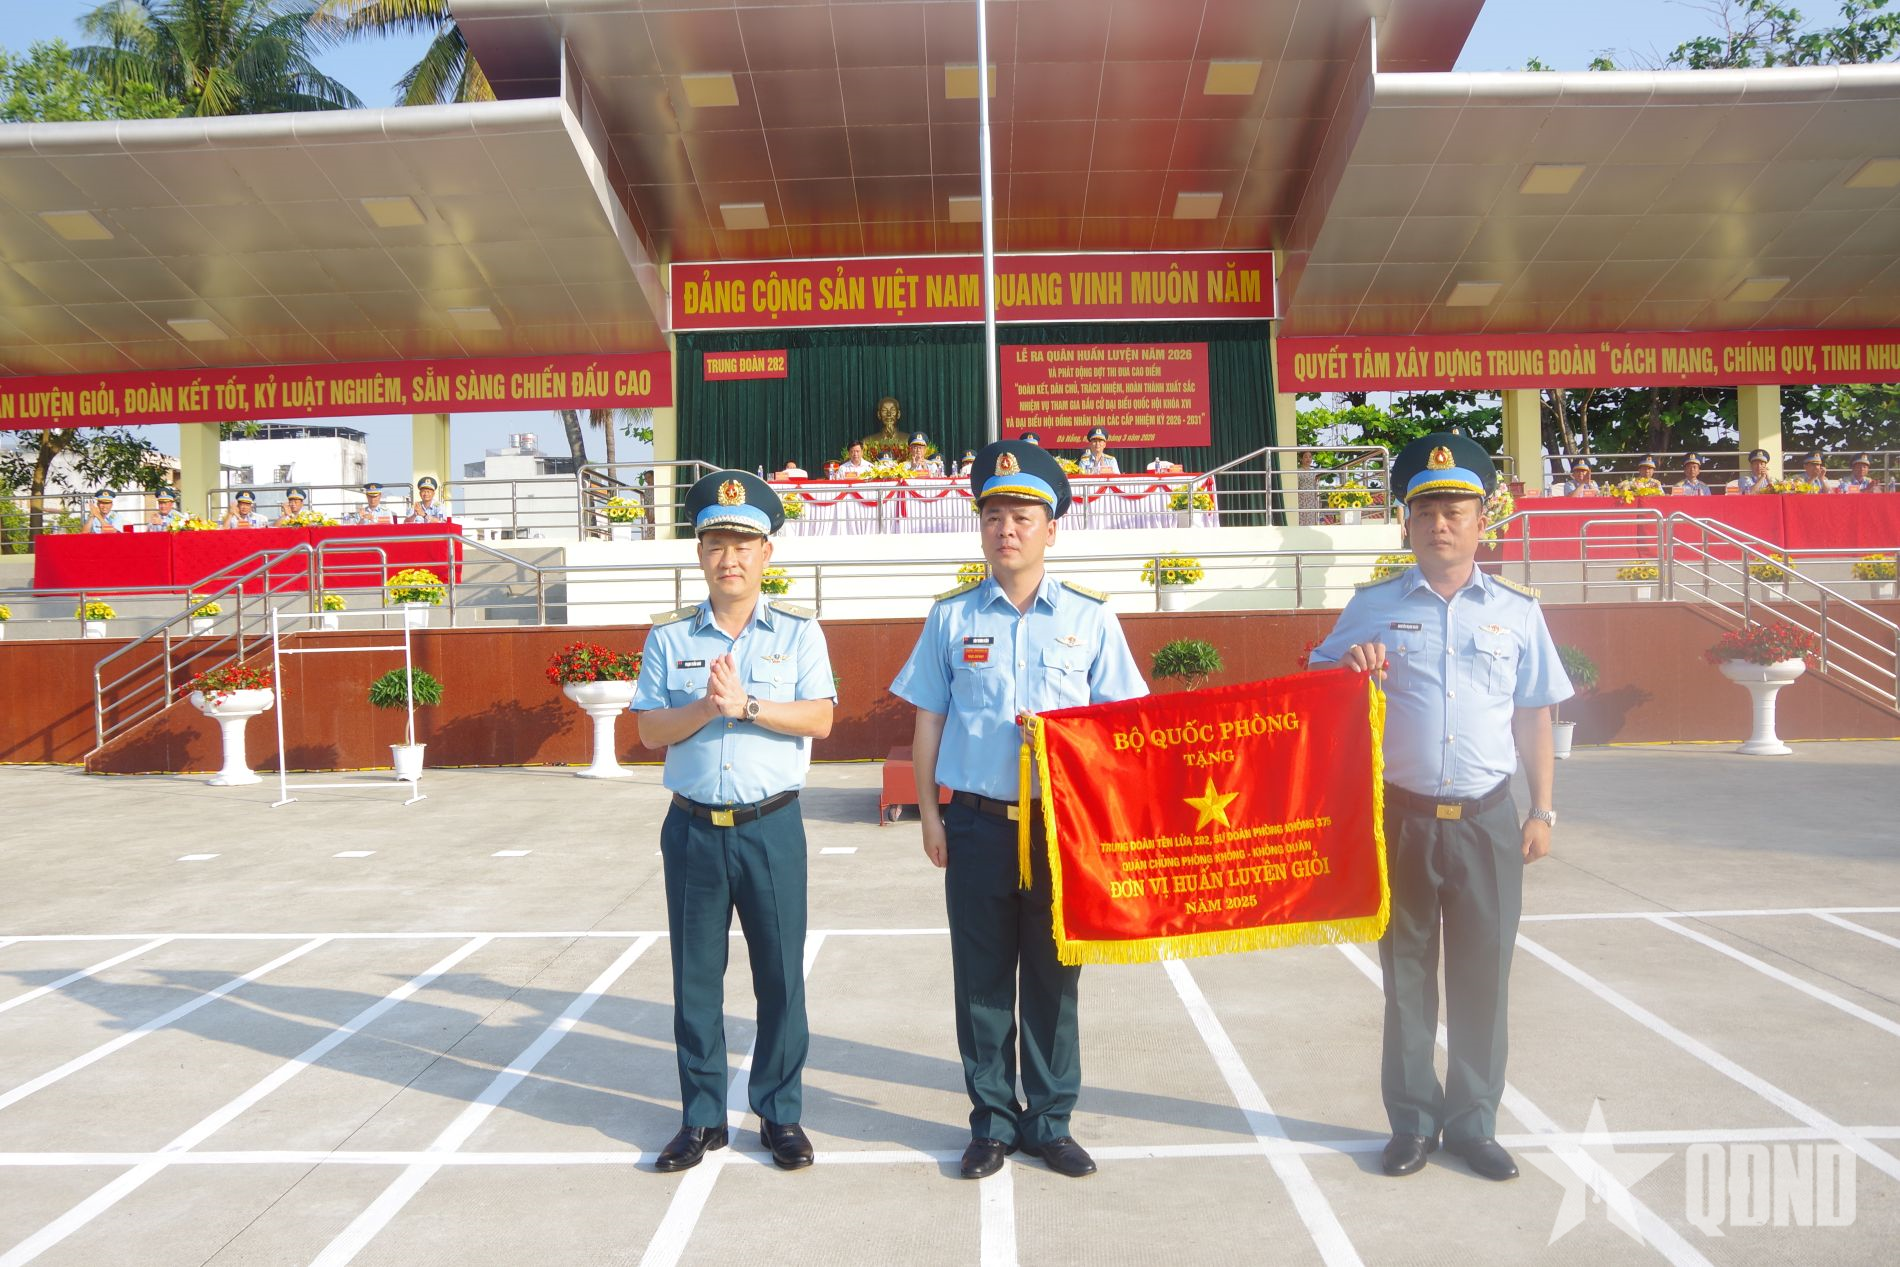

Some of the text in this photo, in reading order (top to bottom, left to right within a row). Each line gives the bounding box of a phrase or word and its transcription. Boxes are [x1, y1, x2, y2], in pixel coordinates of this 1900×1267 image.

[684, 270, 745, 314] ĐẢNG
[752, 271, 811, 319] CỘNG
[819, 266, 864, 310] SẢN
[872, 268, 918, 316] VIỆT
[926, 274, 979, 307] NAM
[1070, 271, 1122, 305] VINH
[1131, 262, 1198, 304] MUÔN
[1207, 261, 1260, 303] NĂM
[1016, 346, 1192, 362] LỄ RA QUÂN HUẤN LUYỆN NĂM 2026
[1294, 345, 1347, 382] QUYẾT
[1353, 347, 1390, 378] TÂM
[1396, 346, 1429, 377] XÂY
[1435, 348, 1482, 382] DỰNG
[1487, 350, 1544, 376] TRUNG
[1549, 344, 1595, 375] ĐOÀN
[1662, 347, 1718, 379] MẠNG,
[1724, 342, 1775, 372] CHÍNH
[1781, 346, 1816, 374] QUY,
[1822, 345, 1860, 370] TINH
[706, 355, 784, 373] TRUNG ĐOÀN 282
[1048, 366, 1056, 378] VÀ
[1058, 366, 1074, 377] PHÁT
[1075, 366, 1092, 380] ĐỘNG
[1108, 367, 1116, 377] THI
[1132, 366, 1144, 376] CAO
[1146, 363, 1161, 376] ĐIỂM
[19, 387, 74, 422] LUYỆN
[80, 381, 119, 417] GIỎI,
[125, 382, 173, 414] ĐOÀN
[178, 378, 210, 411] KẾT
[215, 375, 249, 412] TỐT,
[255, 374, 277, 408] KỶ
[282, 376, 324, 412] LUẬT
[330, 373, 406, 405] NGHIÊM,
[412, 367, 449, 402] SẴN
[456, 369, 504, 400] SÀNG
[511, 364, 565, 399] CHIẾN
[572, 362, 609, 397] ĐẤU
[615, 369, 651, 396] CAO
[1081, 382, 1100, 394] TRÁCH
[1102, 382, 1124, 395] NHIỆM,
[1126, 381, 1142, 392] HOÀN
[1144, 381, 1164, 392] THÀNH
[1166, 380, 1181, 392] XUẤT
[1183, 380, 1195, 392] SẮC
[1020, 399, 1040, 413] NHIỆM
[1042, 401, 1049, 412] VỤ
[1051, 400, 1068, 410] THAM
[1070, 400, 1080, 410] GIA
[1133, 396, 1150, 410] QUỐC
[1152, 397, 1162, 411] HỘI
[1006, 416, 1014, 428] VÀ
[1028, 414, 1041, 427] BIỂU
[1043, 415, 1053, 429] HỘI
[1074, 415, 1091, 426] NHÂN
[1107, 413, 1119, 426] CÁC
[1121, 412, 1134, 425] CẤP
[1135, 414, 1155, 427] NHIỆM
[1166, 416, 1181, 425] 2026
[1114, 712, 1299, 752] BỘ QUỐC PHÒNG
[1183, 750, 1235, 768] TẶNG
[1101, 842, 1129, 853] TRUNG
[1157, 836, 1173, 848] TÊN
[1175, 833, 1192, 846] LỬA
[1194, 836, 1212, 846] 282,
[1253, 824, 1283, 837] PHÒNG
[1316, 817, 1331, 827] 375
[1122, 858, 1147, 872] QUÂN
[1182, 854, 1213, 866] PHÒNG
[1253, 844, 1284, 857] KHÔNG
[1286, 840, 1312, 853] QUÂN
[1110, 850, 1331, 898] ĐƠN VỊ HUẤN LUYỆN GIỎI
[1226, 895, 1257, 909] 2025
